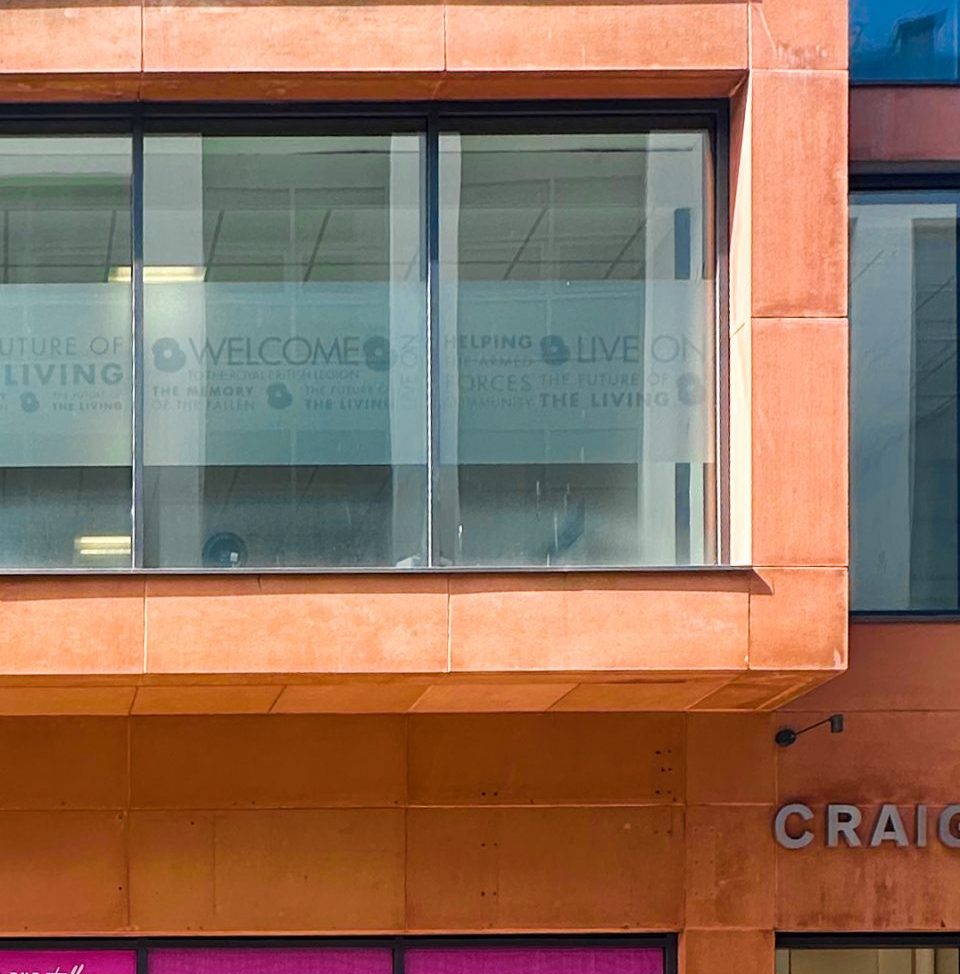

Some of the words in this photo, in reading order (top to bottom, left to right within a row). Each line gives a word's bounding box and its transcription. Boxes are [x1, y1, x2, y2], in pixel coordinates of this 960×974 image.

[89, 335, 124, 356] OF
[445, 334, 533, 349] HELPING
[577, 335, 640, 363] LIVE
[651, 334, 707, 363] ON
[188, 336, 360, 366] WELCOME
[4, 363, 124, 387] LIVING
[541, 373, 570, 387] THE
[577, 373, 639, 387] FUTURE
[649, 373, 669, 387] OF
[152, 385, 179, 398] THE
[186, 385, 254, 397] MEMORY
[78, 402, 123, 411] LIVING
[304, 399, 334, 411] THE
[540, 393, 579, 408] THE
[591, 392, 670, 408] LIVING
